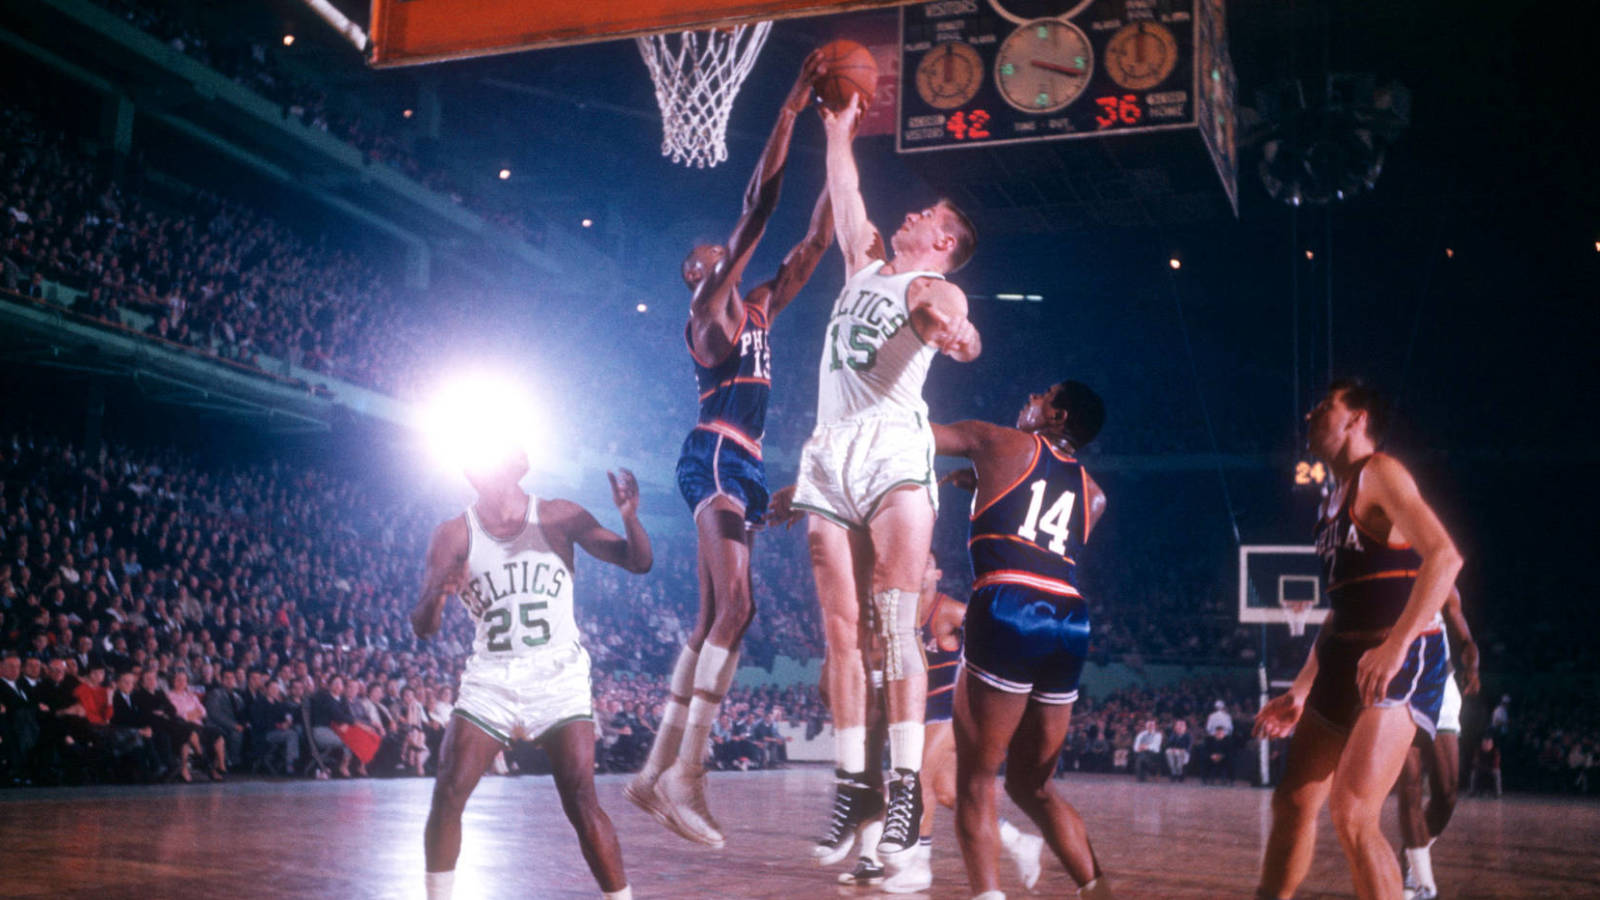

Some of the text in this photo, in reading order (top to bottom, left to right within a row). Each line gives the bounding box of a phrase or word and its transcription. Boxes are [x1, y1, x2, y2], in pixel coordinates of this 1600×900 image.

[947, 109, 991, 140] 42
[1096, 95, 1141, 127] 36
[837, 290, 907, 340] LTICS
[829, 323, 879, 372] 15
[1295, 461, 1326, 485] 24
[1018, 479, 1076, 556] 14
[460, 561, 566, 619] CELTICS
[484, 600, 551, 652] 25
